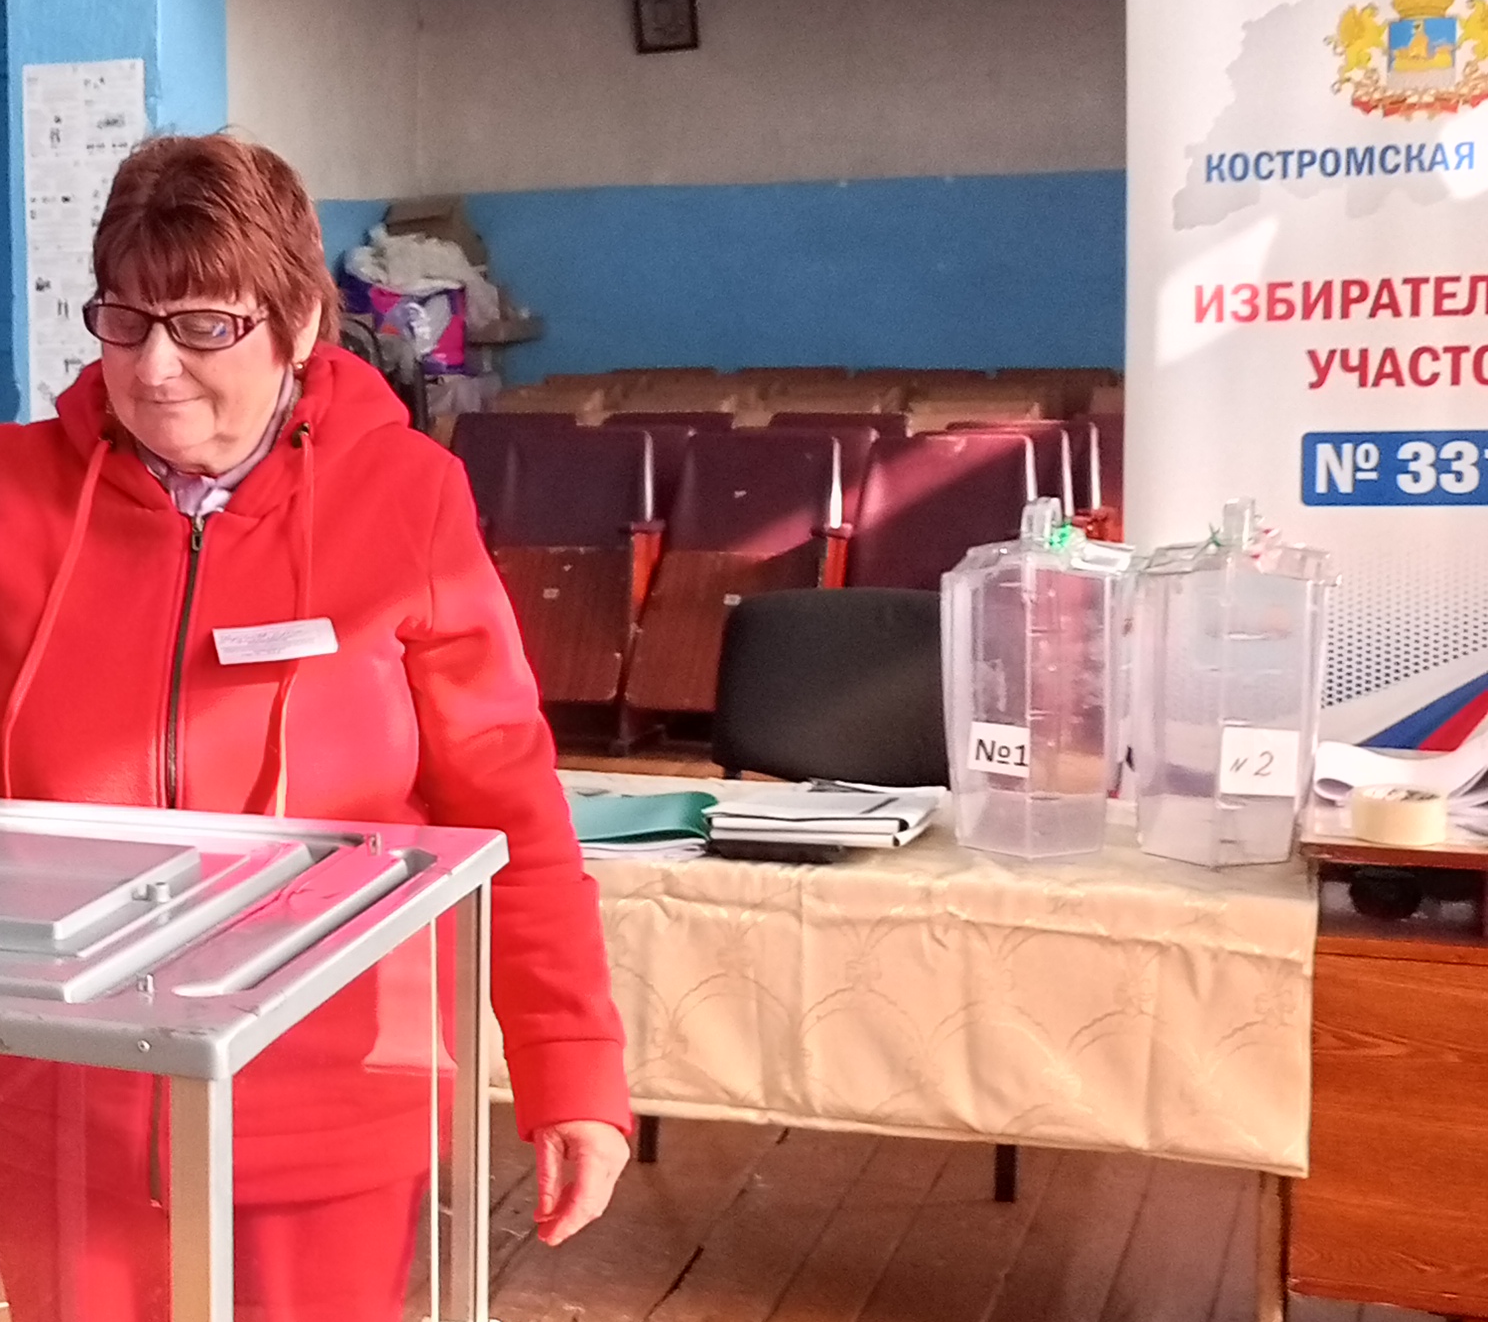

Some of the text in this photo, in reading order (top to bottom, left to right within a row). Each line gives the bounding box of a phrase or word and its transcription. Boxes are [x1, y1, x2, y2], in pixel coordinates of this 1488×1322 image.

[1204, 141, 1476, 184] КОСТРОМСКАЯ
[1315, 440, 1488, 495] № 33
[974, 738, 1030, 768] №1
